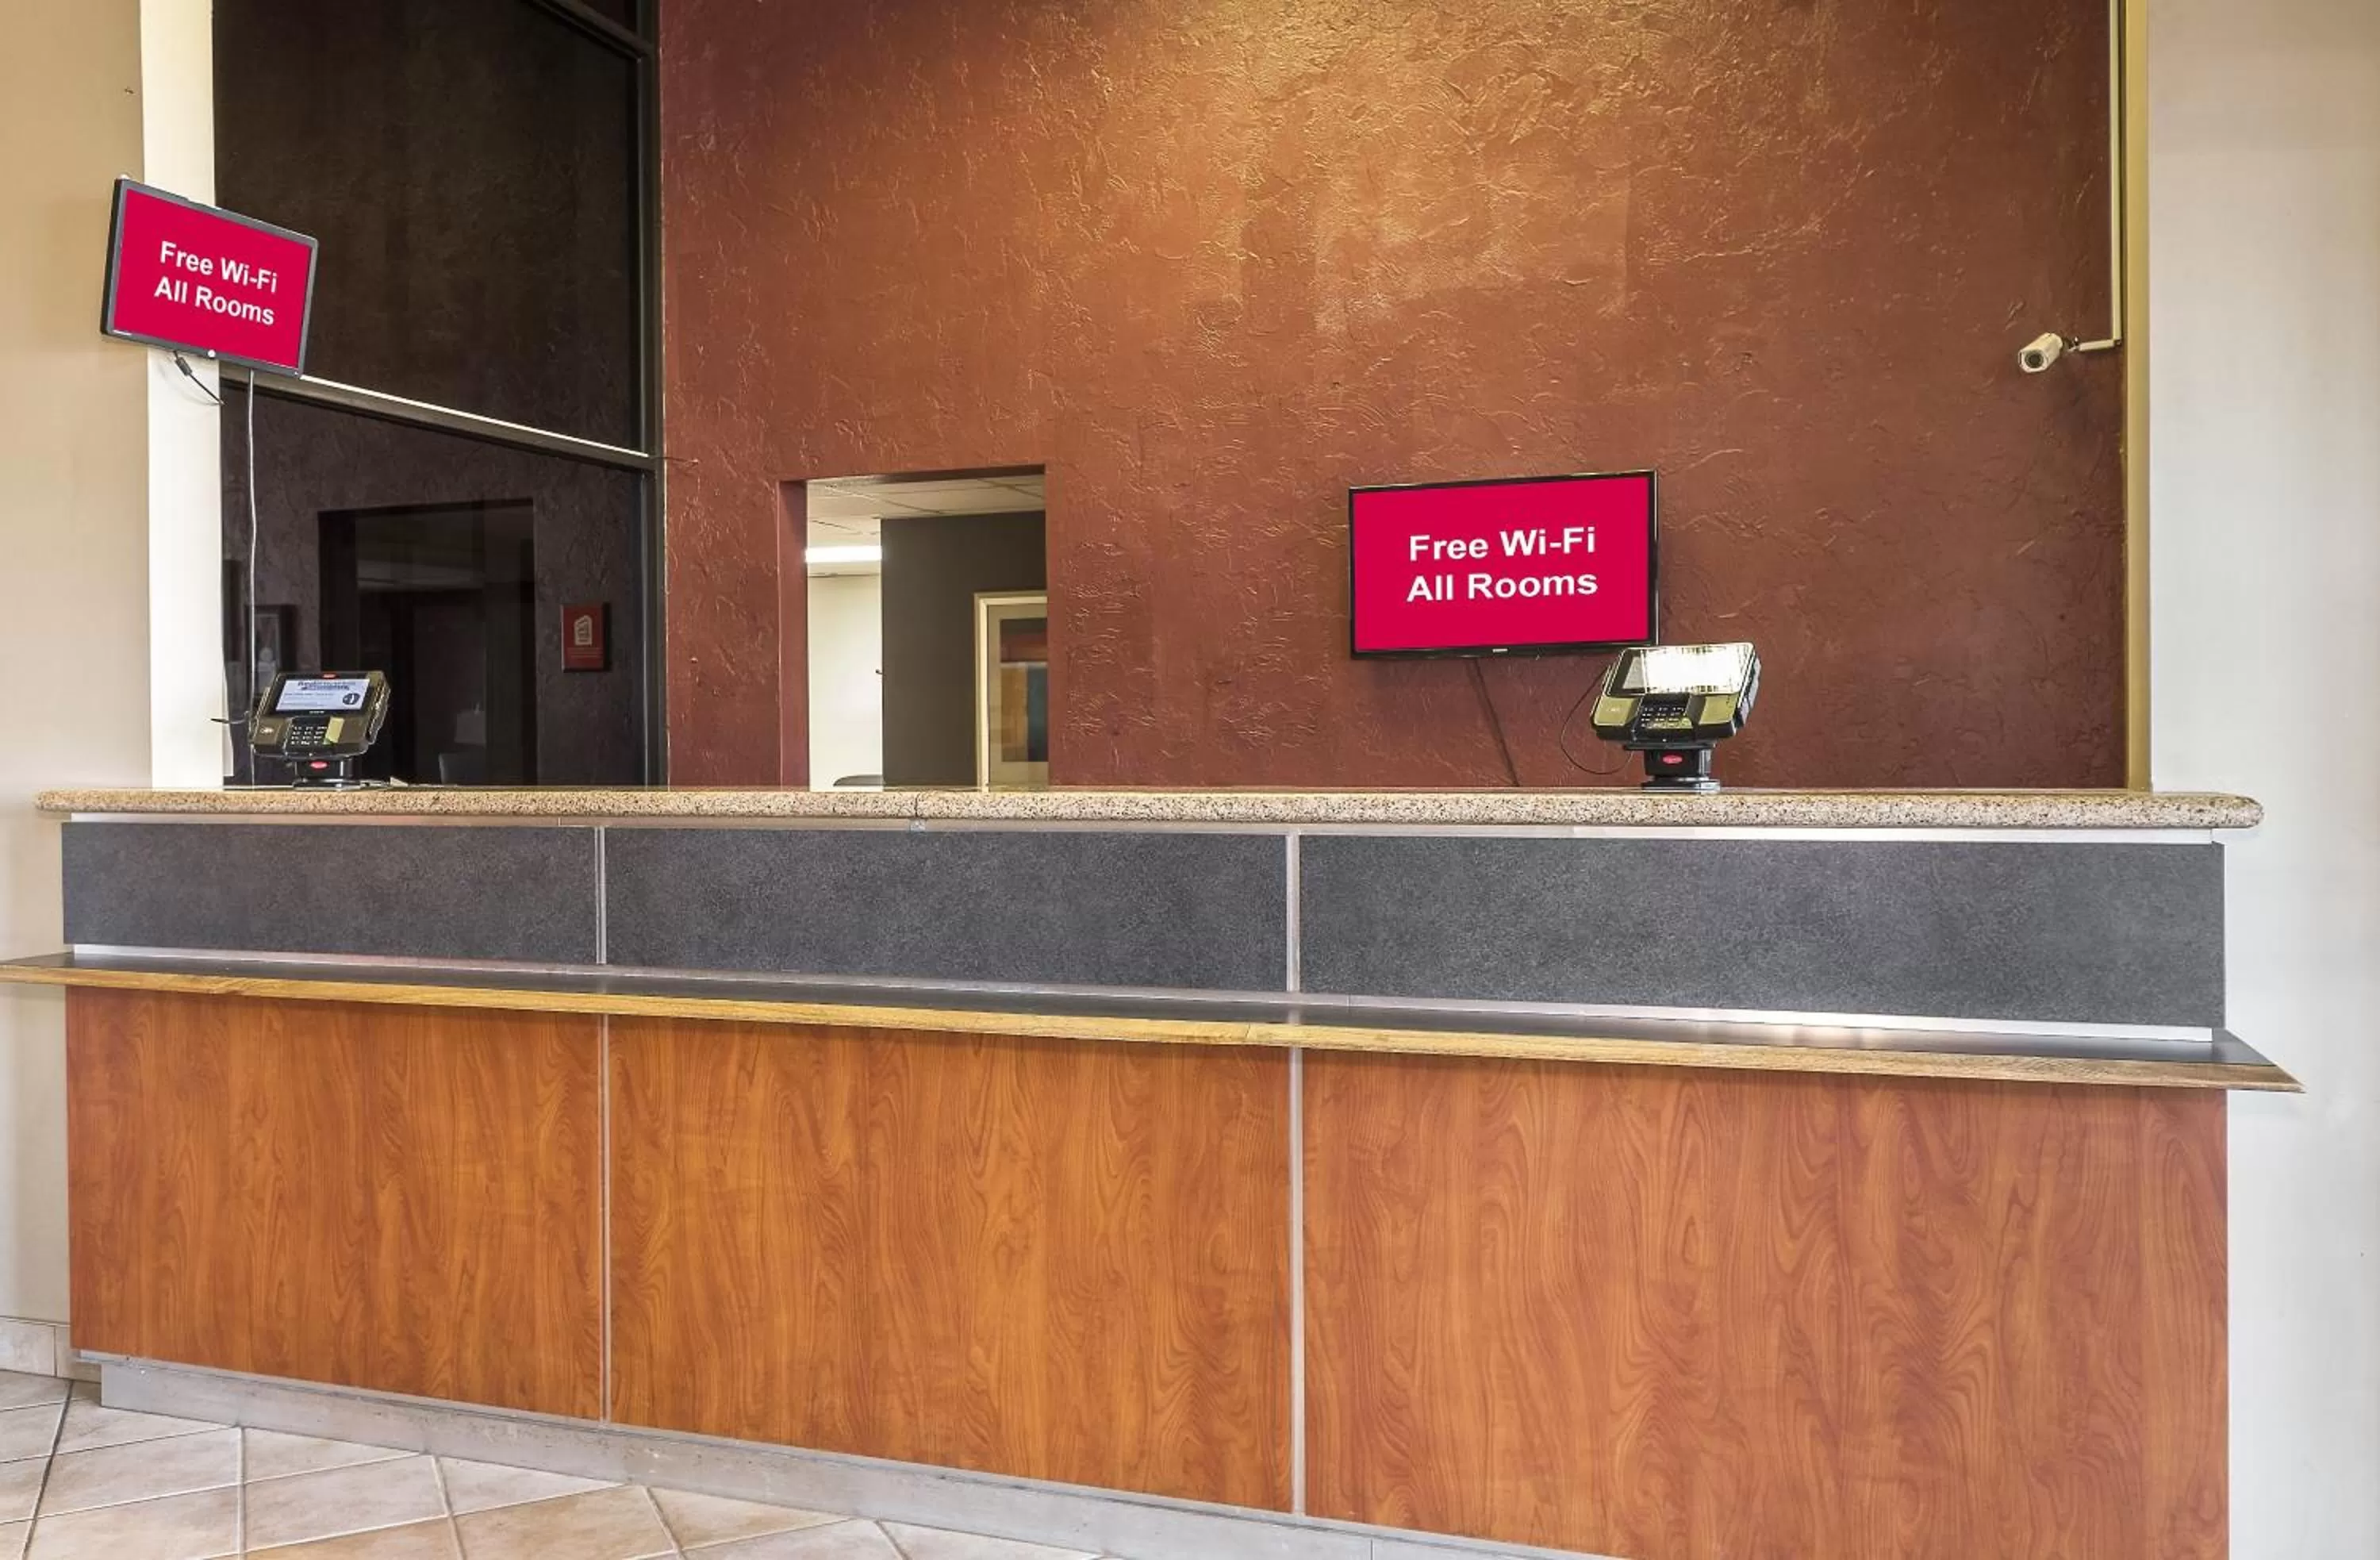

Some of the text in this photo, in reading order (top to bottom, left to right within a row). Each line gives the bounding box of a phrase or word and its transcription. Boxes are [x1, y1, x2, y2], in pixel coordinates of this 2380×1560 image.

[160, 240, 278, 293] Free Wi-Fi
[154, 275, 274, 325] All Rooms
[1409, 526, 1595, 561] Free Wi-Fi
[1407, 573, 1599, 602] All Rooms
